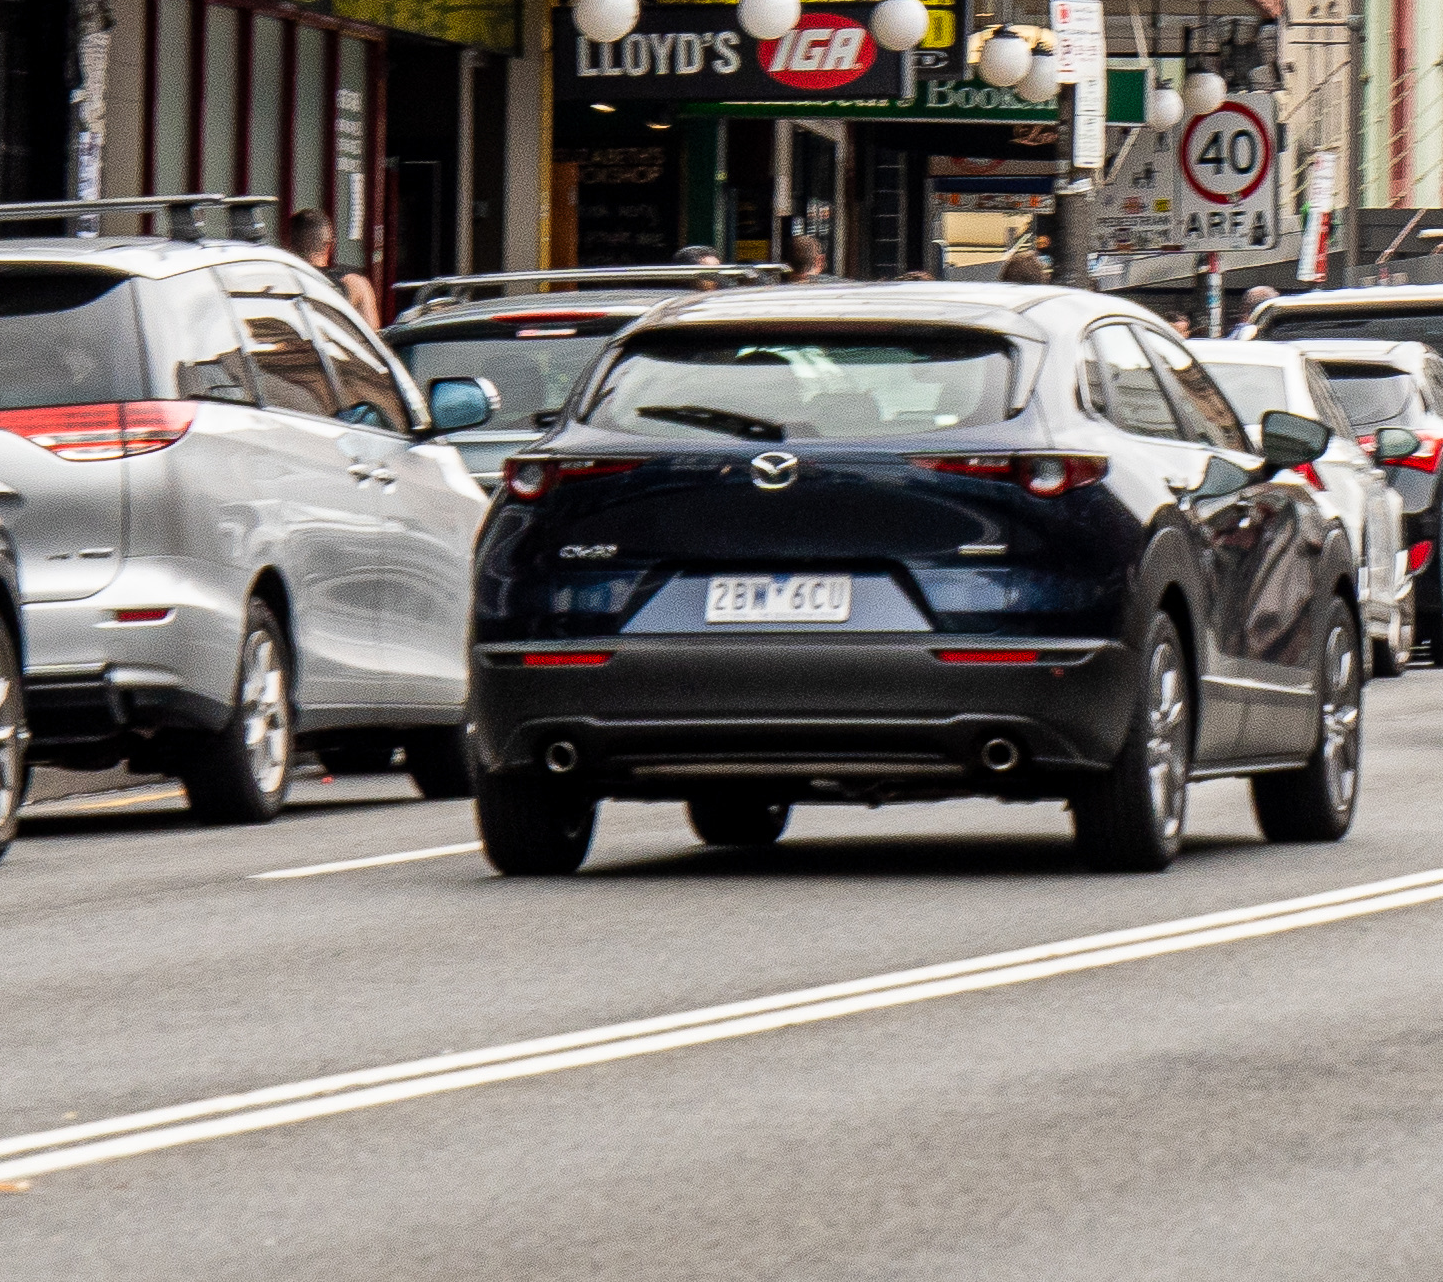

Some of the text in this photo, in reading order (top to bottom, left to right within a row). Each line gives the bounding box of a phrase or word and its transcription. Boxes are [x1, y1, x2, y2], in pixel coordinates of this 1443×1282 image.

[575, 27, 866, 80] LLOYD'S IGA
[1196, 129, 1258, 176] 40
